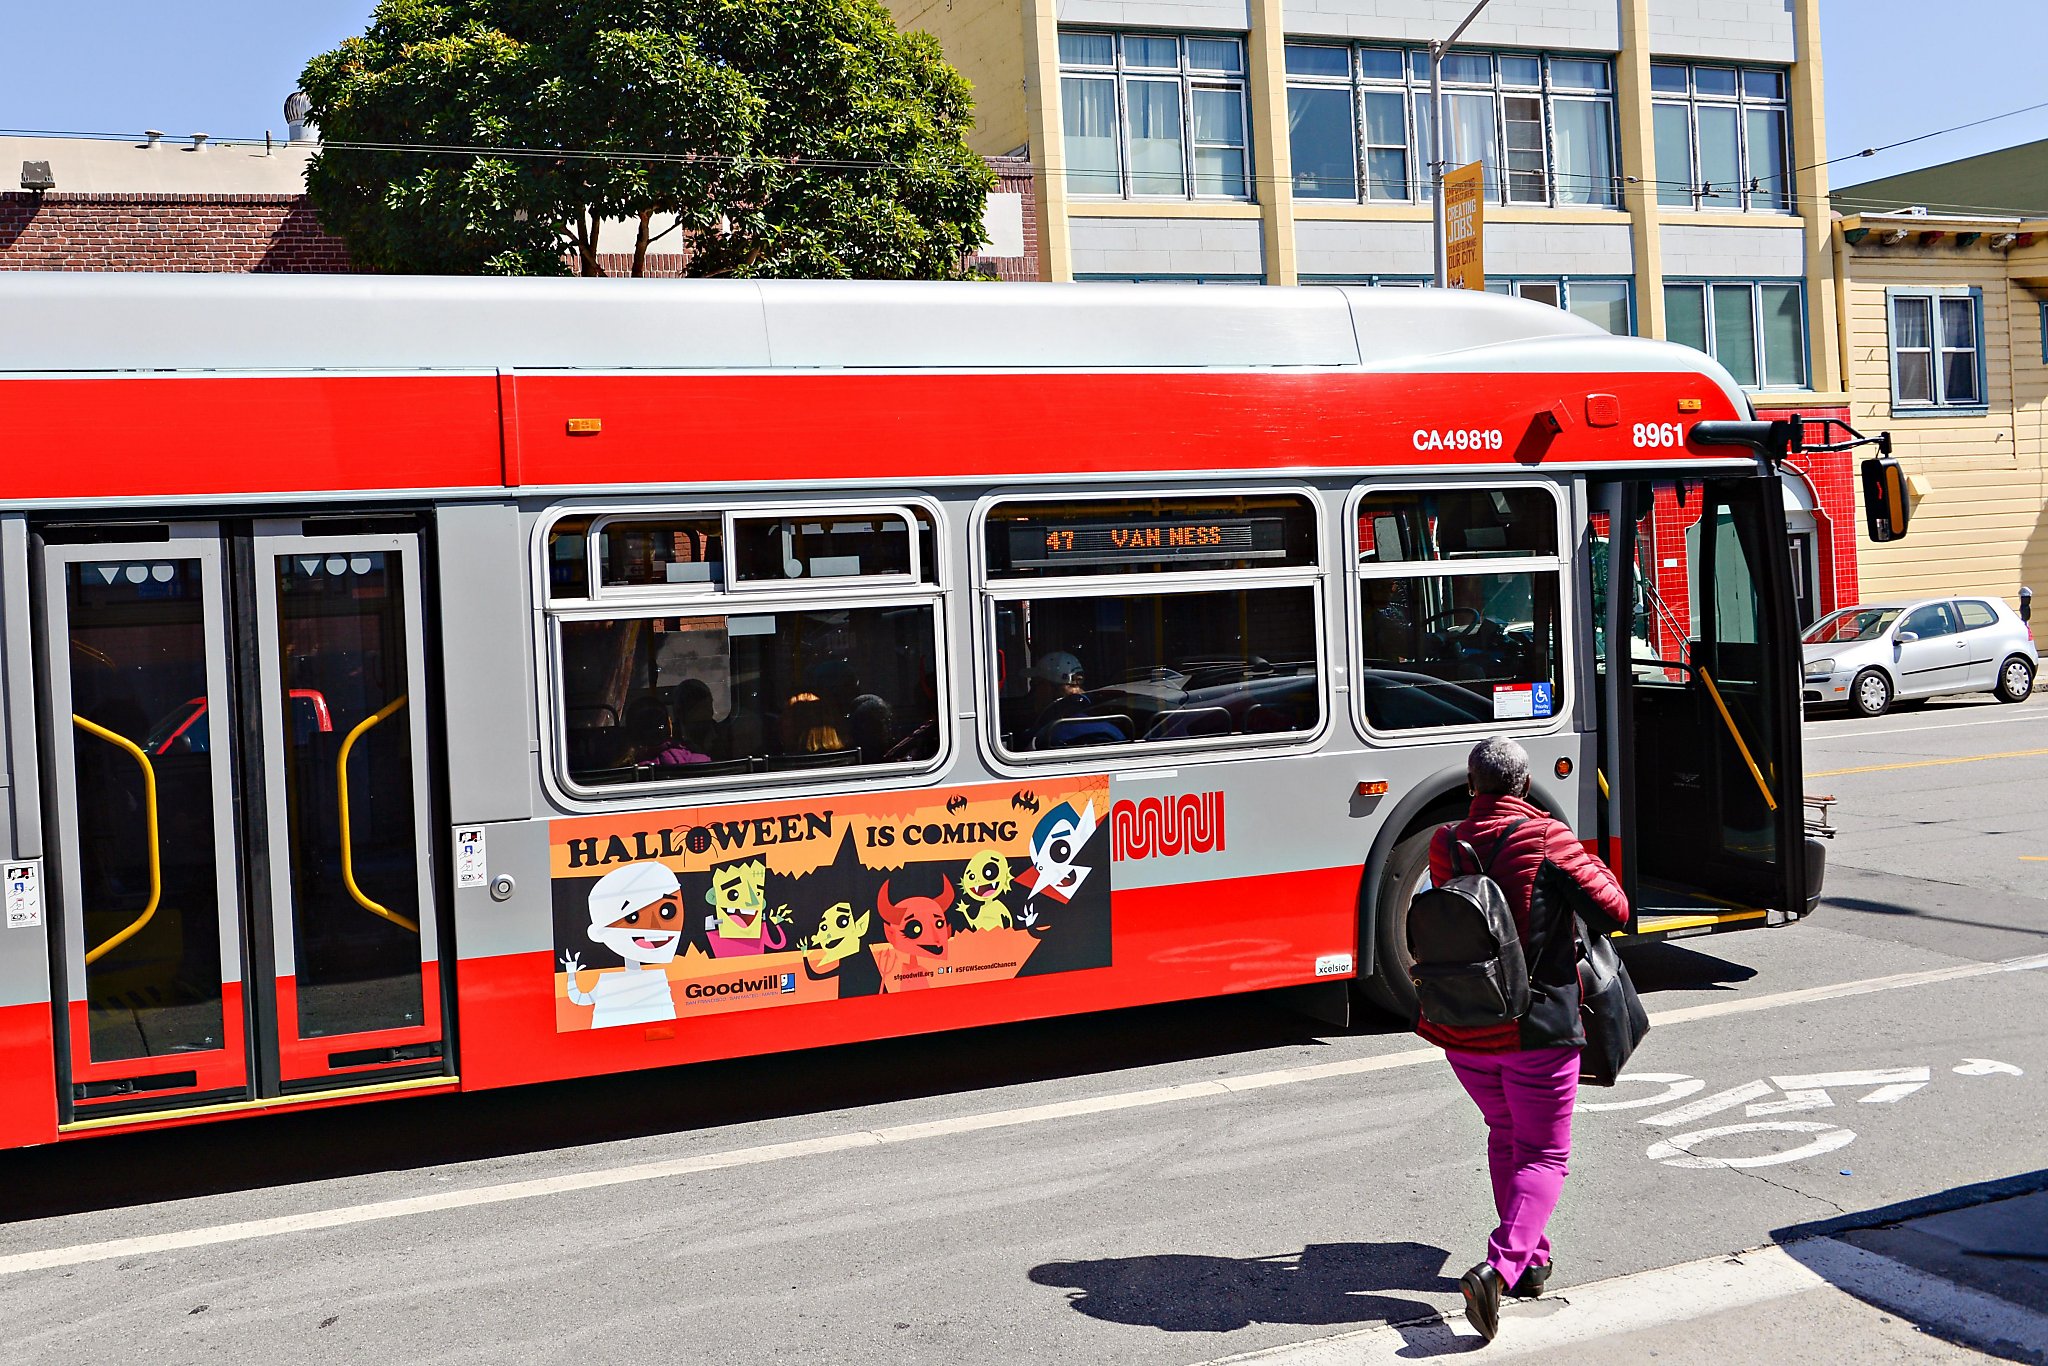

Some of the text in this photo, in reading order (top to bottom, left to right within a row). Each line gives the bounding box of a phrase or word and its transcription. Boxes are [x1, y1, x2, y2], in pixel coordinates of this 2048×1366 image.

[1448, 199, 1476, 221] CREATING
[1449, 216, 1476, 243] JOBS.
[1448, 248, 1478, 269] OUR CITY.
[1412, 429, 1503, 451] CA49819
[1632, 422, 1684, 448] 8961
[1046, 526, 1221, 550] 47 VAN NESS
[567, 810, 1019, 868] HALLOWEEN IS COMING
[893, 961, 1017, 981] sfgoodwill.org #SFGWSecondChances
[1319, 964, 1350, 974] xcelsior
[685, 974, 778, 999] Goodwill
